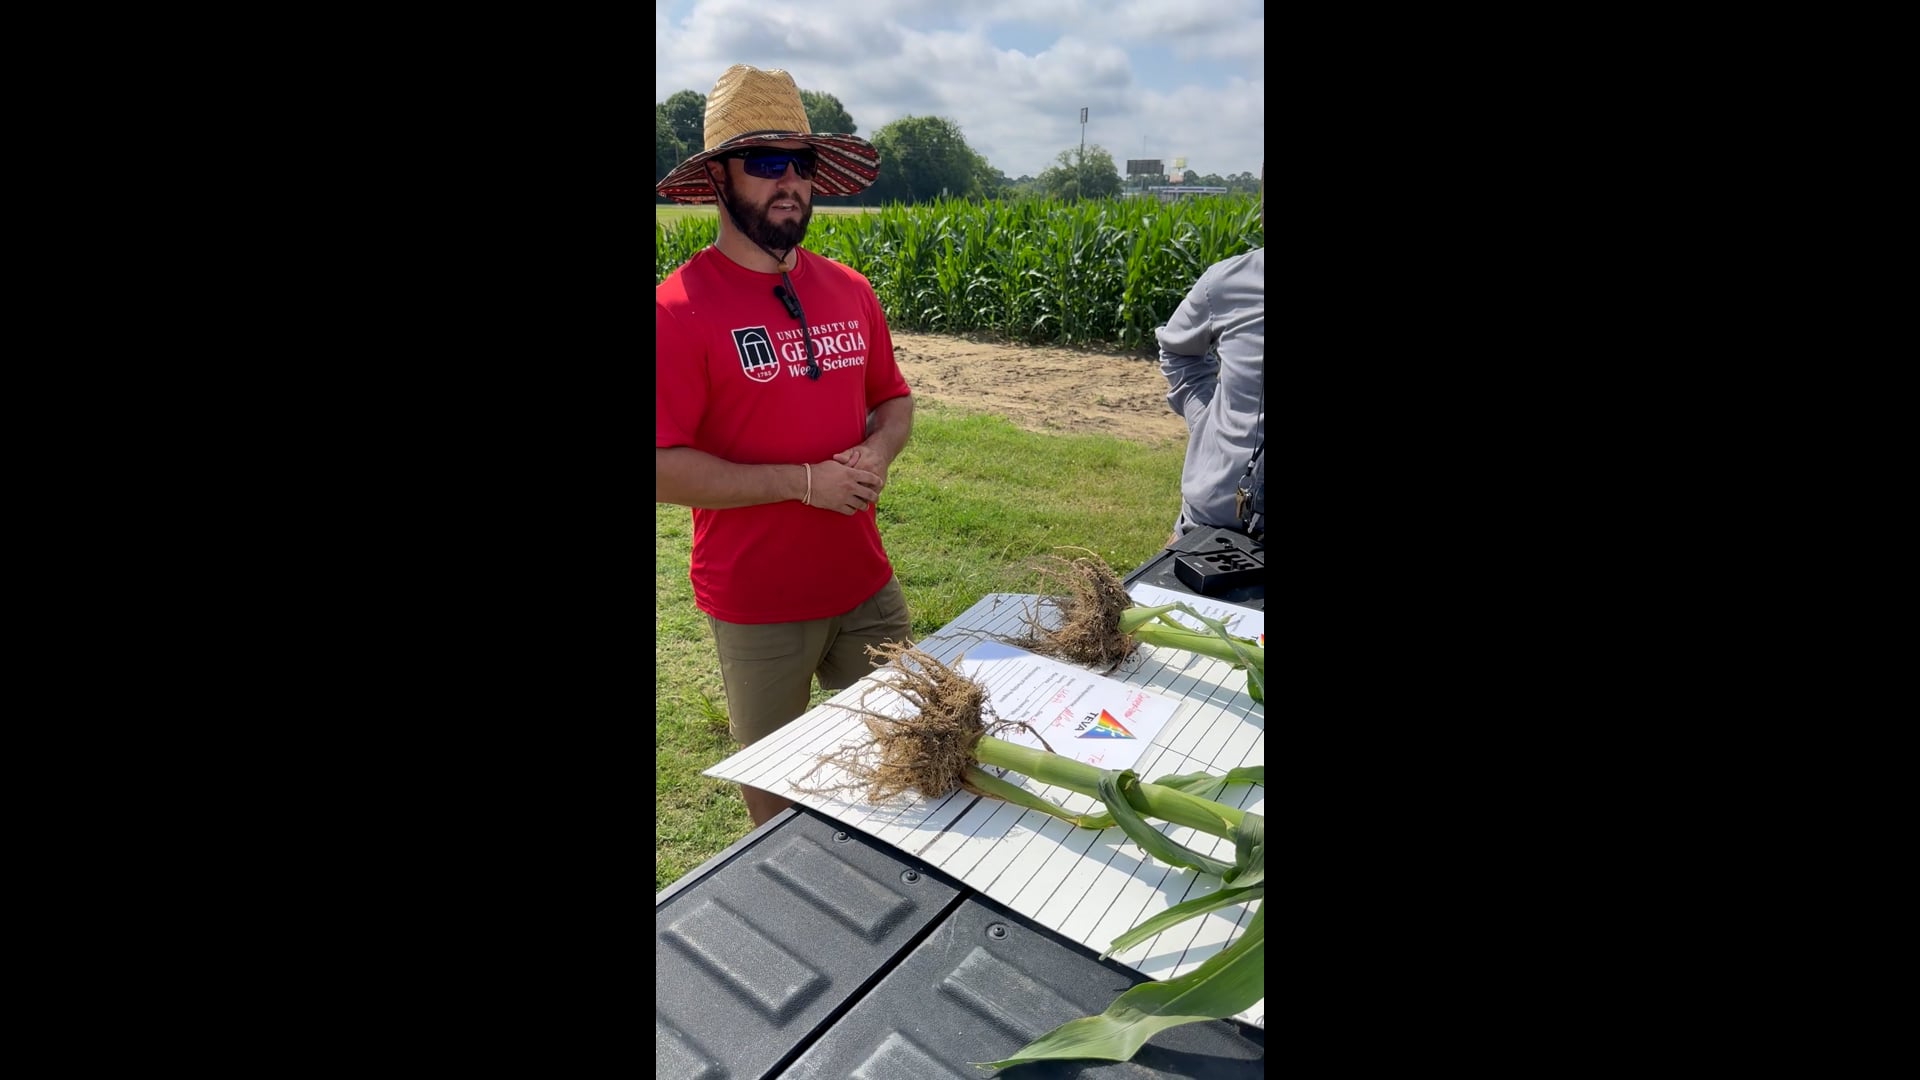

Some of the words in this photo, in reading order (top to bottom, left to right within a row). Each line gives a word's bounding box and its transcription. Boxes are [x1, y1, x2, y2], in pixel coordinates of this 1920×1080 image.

[848, 320, 859, 329] OF
[781, 331, 866, 362] GEORGIA
[822, 354, 865, 371] Science
[1074, 712, 1099, 731] TEVA
